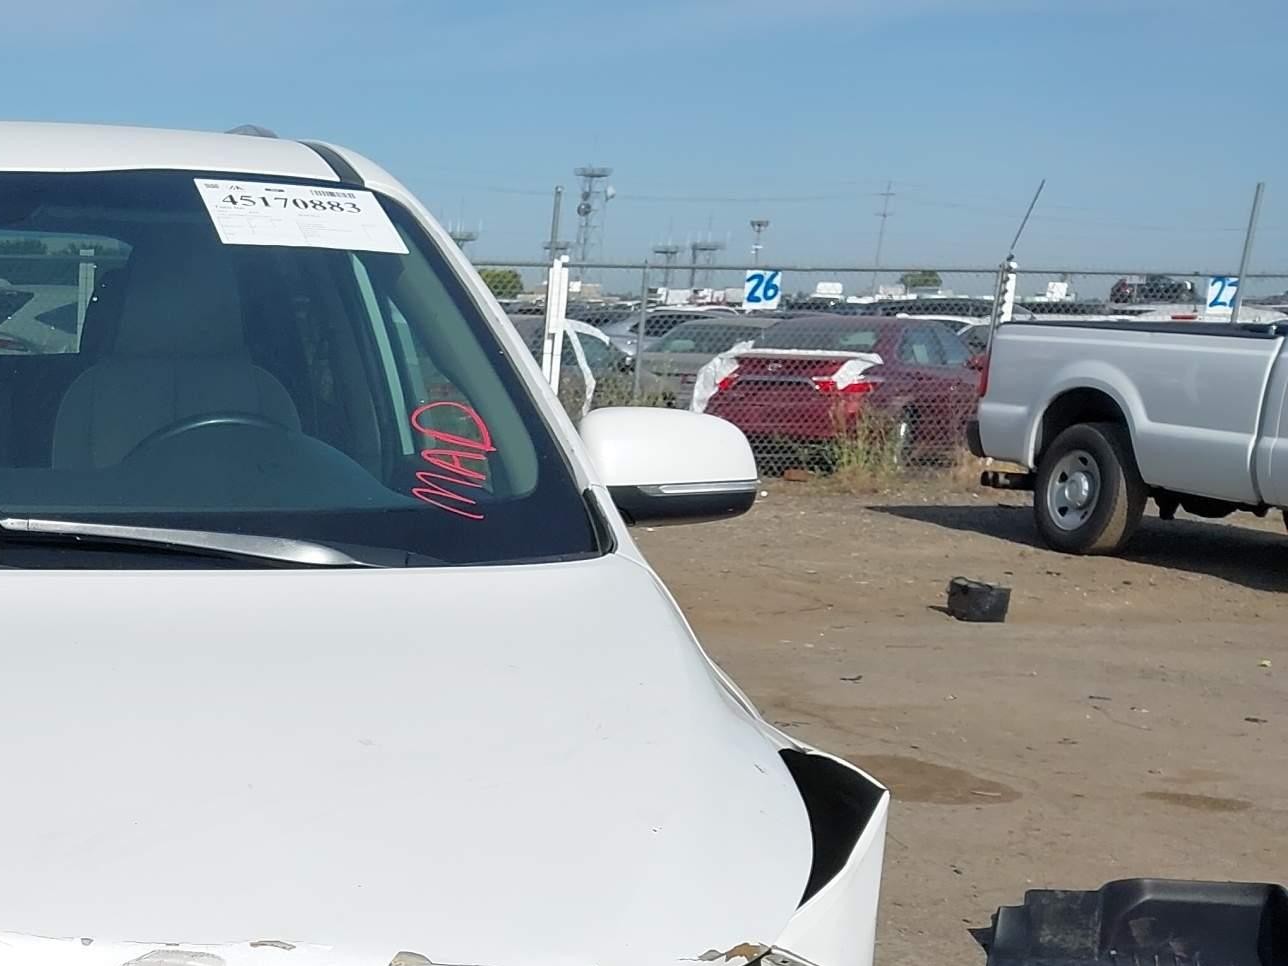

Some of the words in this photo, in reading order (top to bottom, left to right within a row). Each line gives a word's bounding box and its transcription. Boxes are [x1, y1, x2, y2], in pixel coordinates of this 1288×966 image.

[221, 194, 362, 214] 45170883
[746, 271, 779, 303] 26
[1209, 276, 1239, 307] 27
[411, 401, 497, 519] MAD
